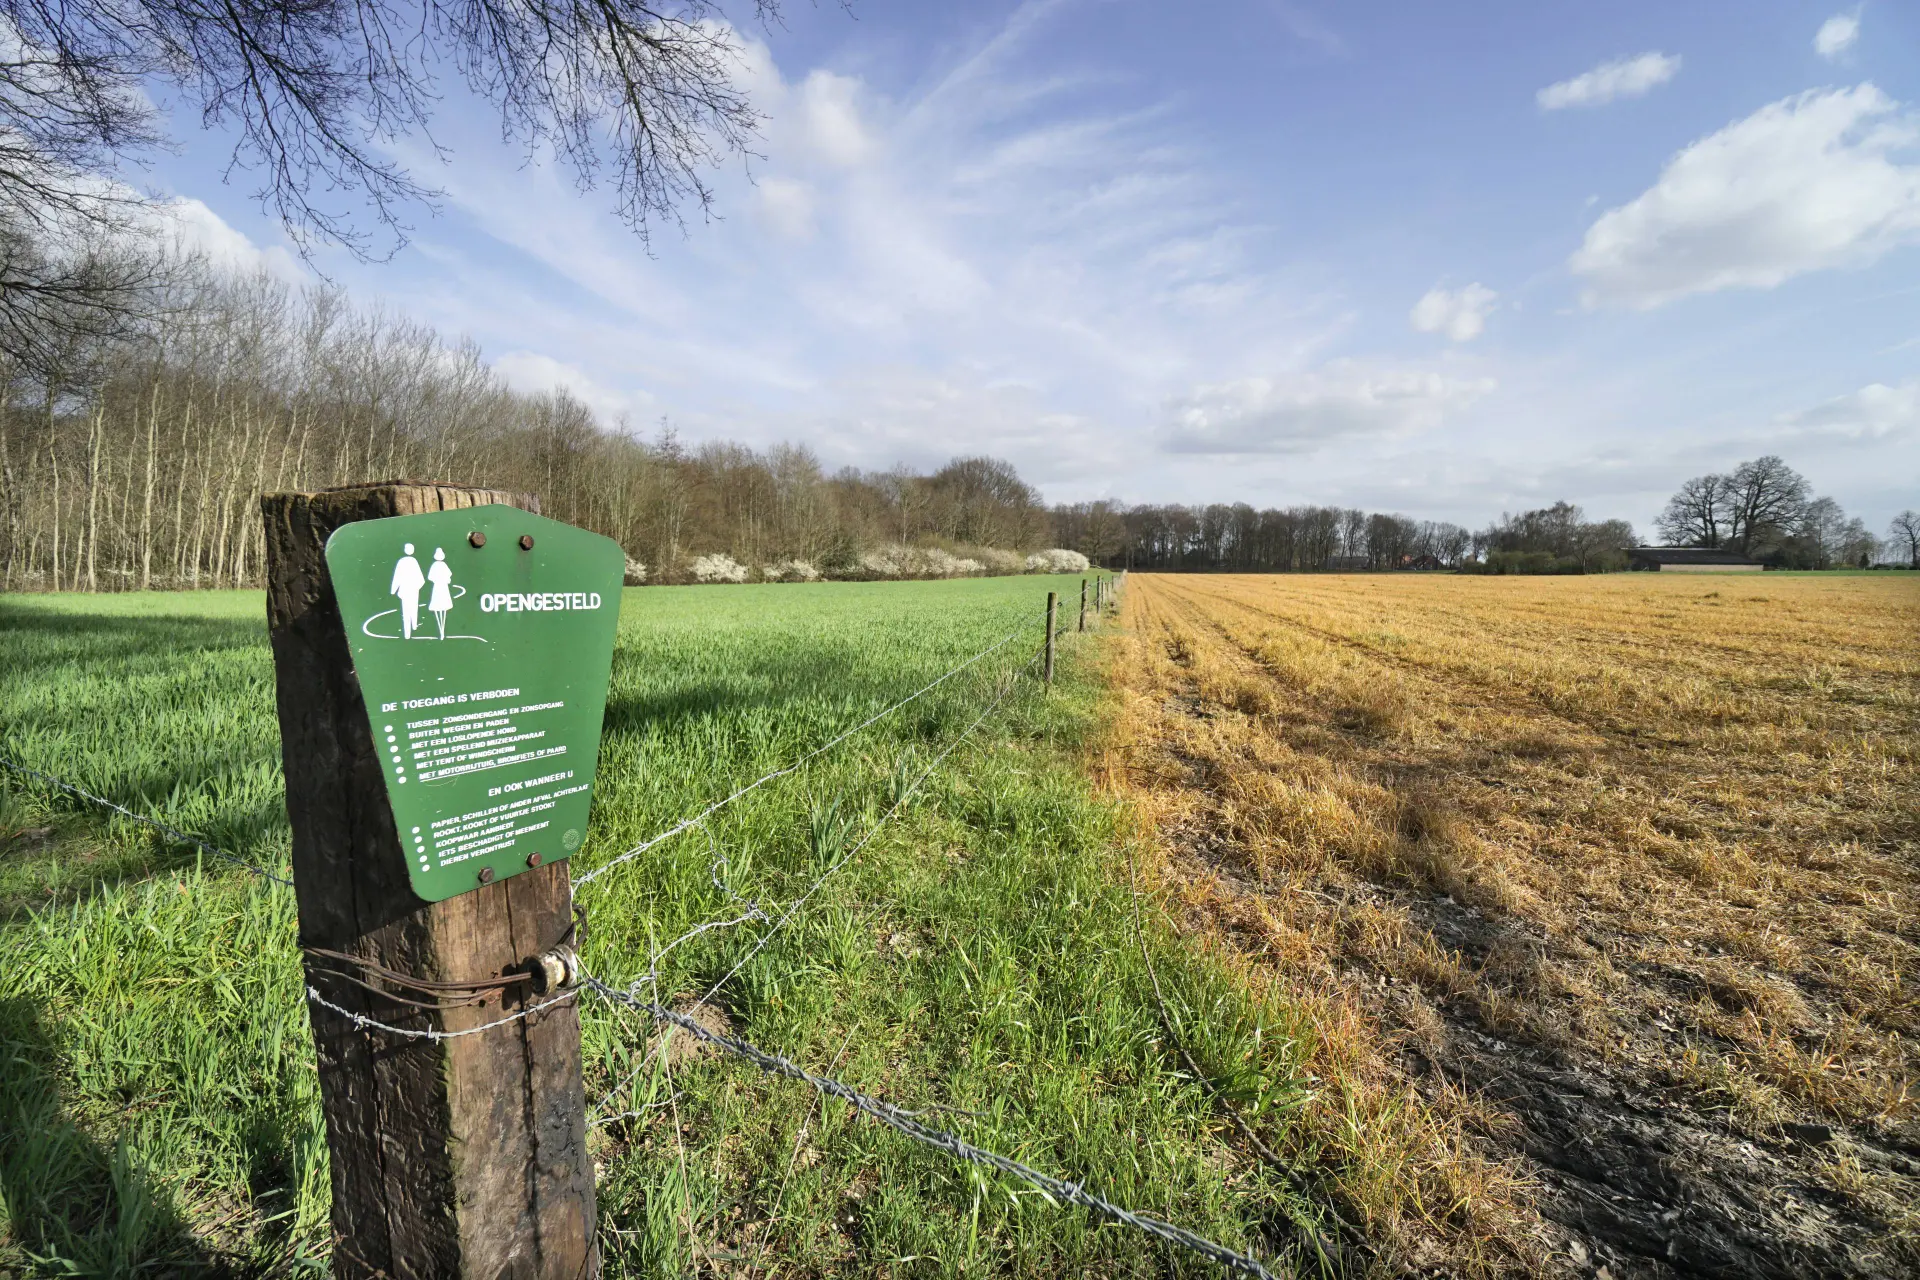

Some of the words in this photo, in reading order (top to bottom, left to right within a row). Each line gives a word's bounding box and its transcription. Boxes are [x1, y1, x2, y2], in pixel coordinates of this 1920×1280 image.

[481, 593, 601, 612] OPENGESTELD
[382, 702, 397, 712] DE
[402, 695, 455, 709] TOEGANG
[458, 694, 467, 703] IS
[470, 688, 519, 701] VERBODEN
[407, 719, 439, 729] TUSSEN
[443, 709, 507, 724] ZONSONDERGANG
[521, 702, 564, 712] ZONSOPGANG
[409, 729, 440, 739] BUITEN
[443, 724, 471, 734] WEGEN
[486, 718, 509, 728] PADEN
[411, 741, 428, 749] MET
[431, 738, 446, 746] EEN
[448, 730, 495, 743] LOSLOPENDE
[497, 726, 516, 735] HOND
[414, 751, 431, 759] MET
[434, 747, 449, 756] EEN
[451, 741, 485, 753] SPELEND
[487, 731, 545, 746] MUZIEKAPPARAAT
[416, 761, 434, 770] MET
[436, 756, 455, 765] TENT
[457, 754, 467, 762] OF
[469, 745, 515, 759] WINDSCHERM
[419, 771, 436, 780] MET
[438, 759, 496, 776] MOTORRIJTUIG,
[547, 745, 566, 754] PAARD
[488, 787, 501, 796] EN
[504, 781, 523, 792] OOK
[525, 773, 565, 788] WANNEER
[568, 770, 573, 778] U
[431, 817, 461, 829] PAPIER,
[462, 807, 498, 821] SCHILLEN
[500, 803, 508, 811] OF
[510, 797, 531, 809] ANDER
[533, 794, 552, 803] AFVAL
[554, 784, 589, 798] ACHTERLAAT
[434, 826, 462, 838] ROOKT,
[462, 819, 488, 831] KOOKT
[490, 816, 498, 824] OF
[500, 808, 530, 821] VUURTJE
[531, 801, 556, 812] STOOKT
[436, 832, 479, 848] KOOPWAAR
[480, 822, 514, 835] AANBIEDT
[439, 848, 456, 858] IETS
[458, 834, 504, 852] BESCHADIGT
[515, 821, 550, 835] MEENEEMT
[440, 854, 469, 866] DIEREN
[470, 840, 515, 858] VERONTRUST
